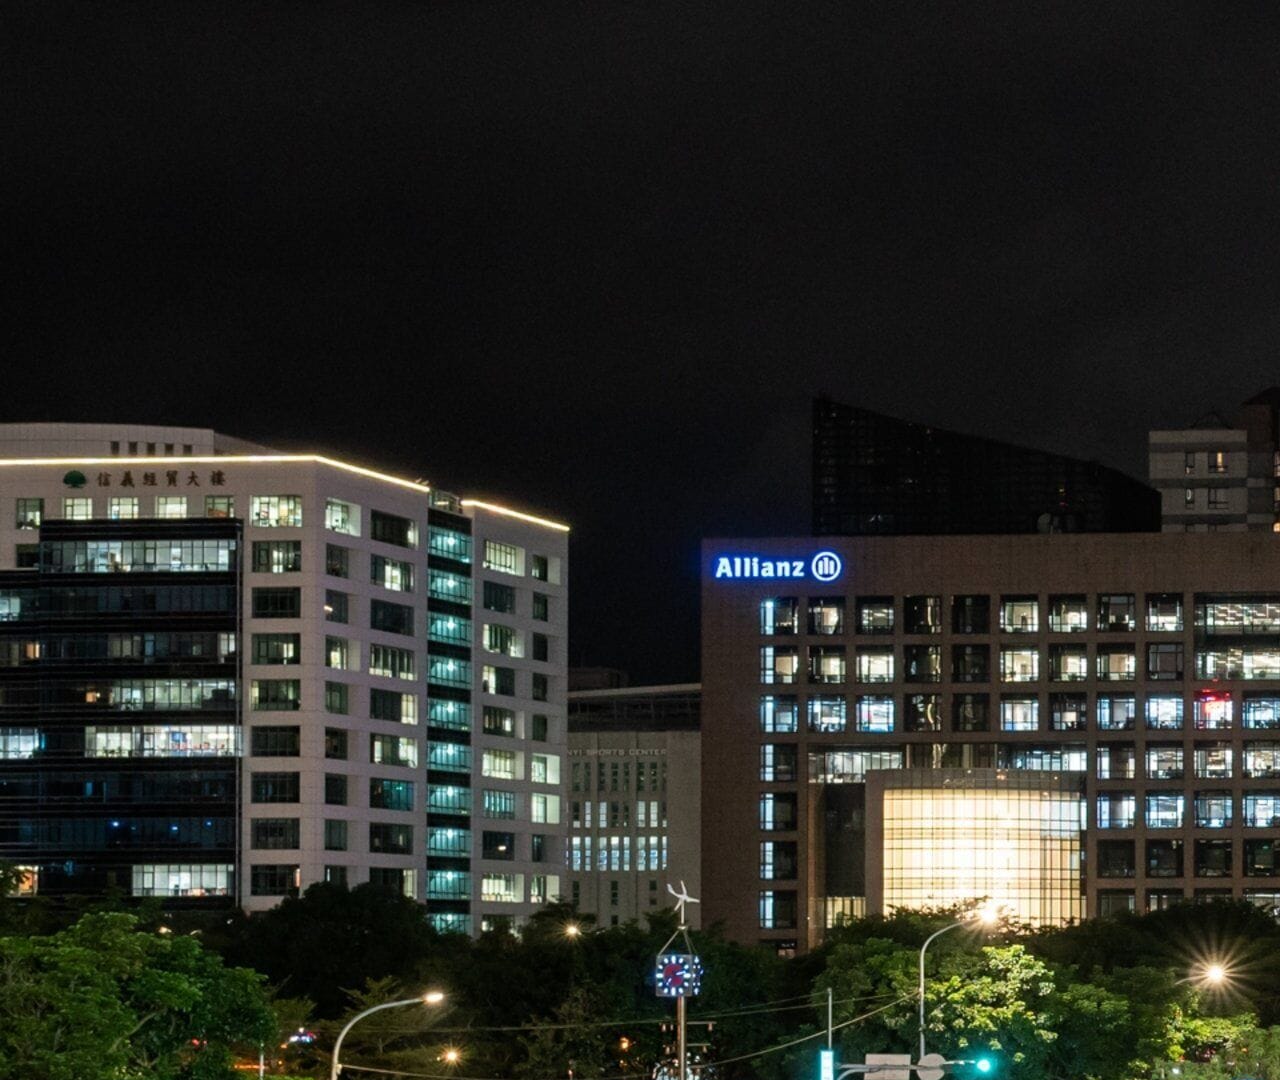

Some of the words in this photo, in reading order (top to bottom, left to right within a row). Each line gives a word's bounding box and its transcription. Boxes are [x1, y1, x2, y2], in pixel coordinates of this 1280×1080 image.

[97, 470, 226, 488] 信義經貿大樓
[715, 557, 805, 578] Allianz
[628, 748, 667, 757] CENTER
